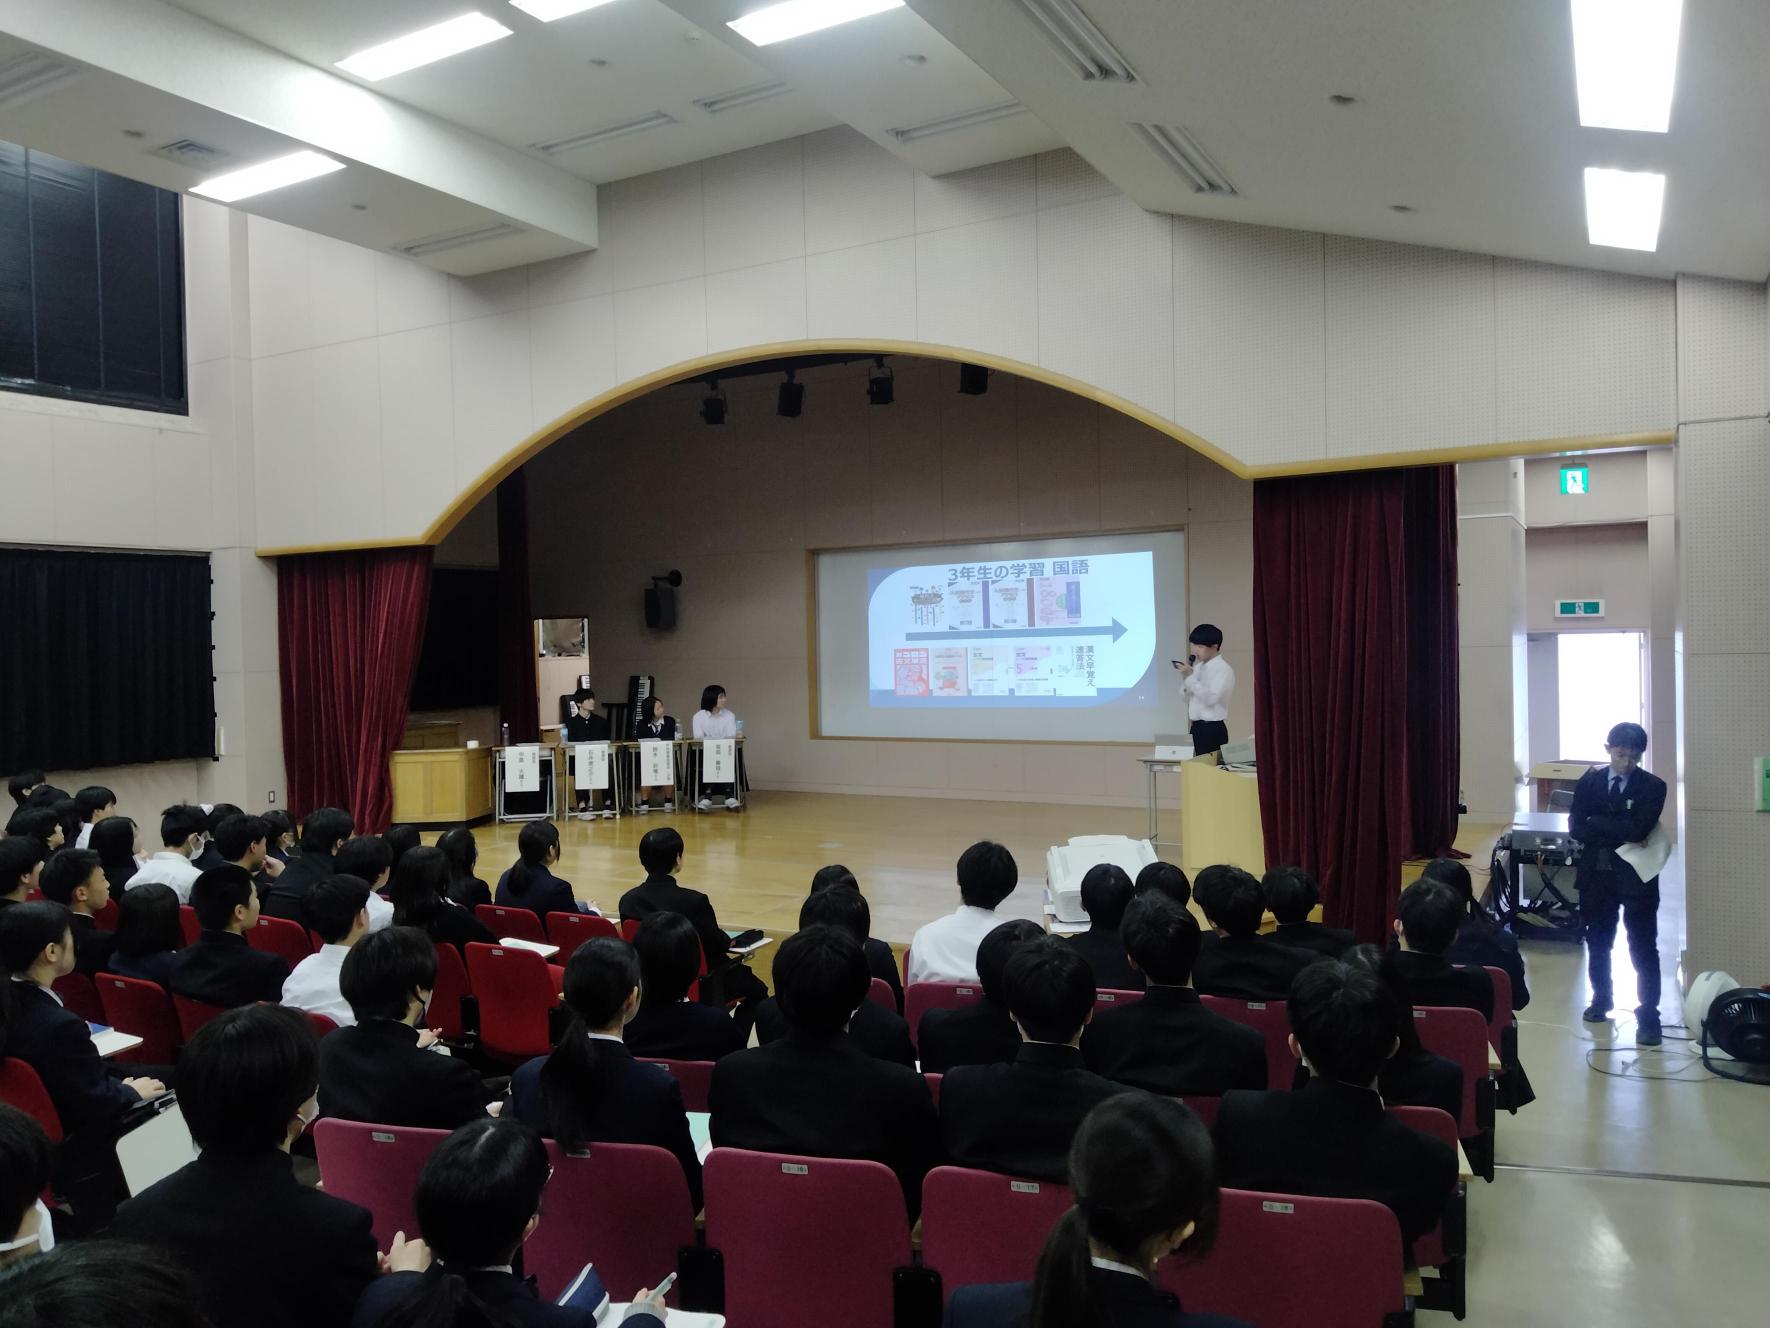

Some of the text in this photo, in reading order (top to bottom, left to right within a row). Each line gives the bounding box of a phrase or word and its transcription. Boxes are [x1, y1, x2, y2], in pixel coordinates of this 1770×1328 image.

[948, 559, 1089, 581] 3年生の学習 国語
